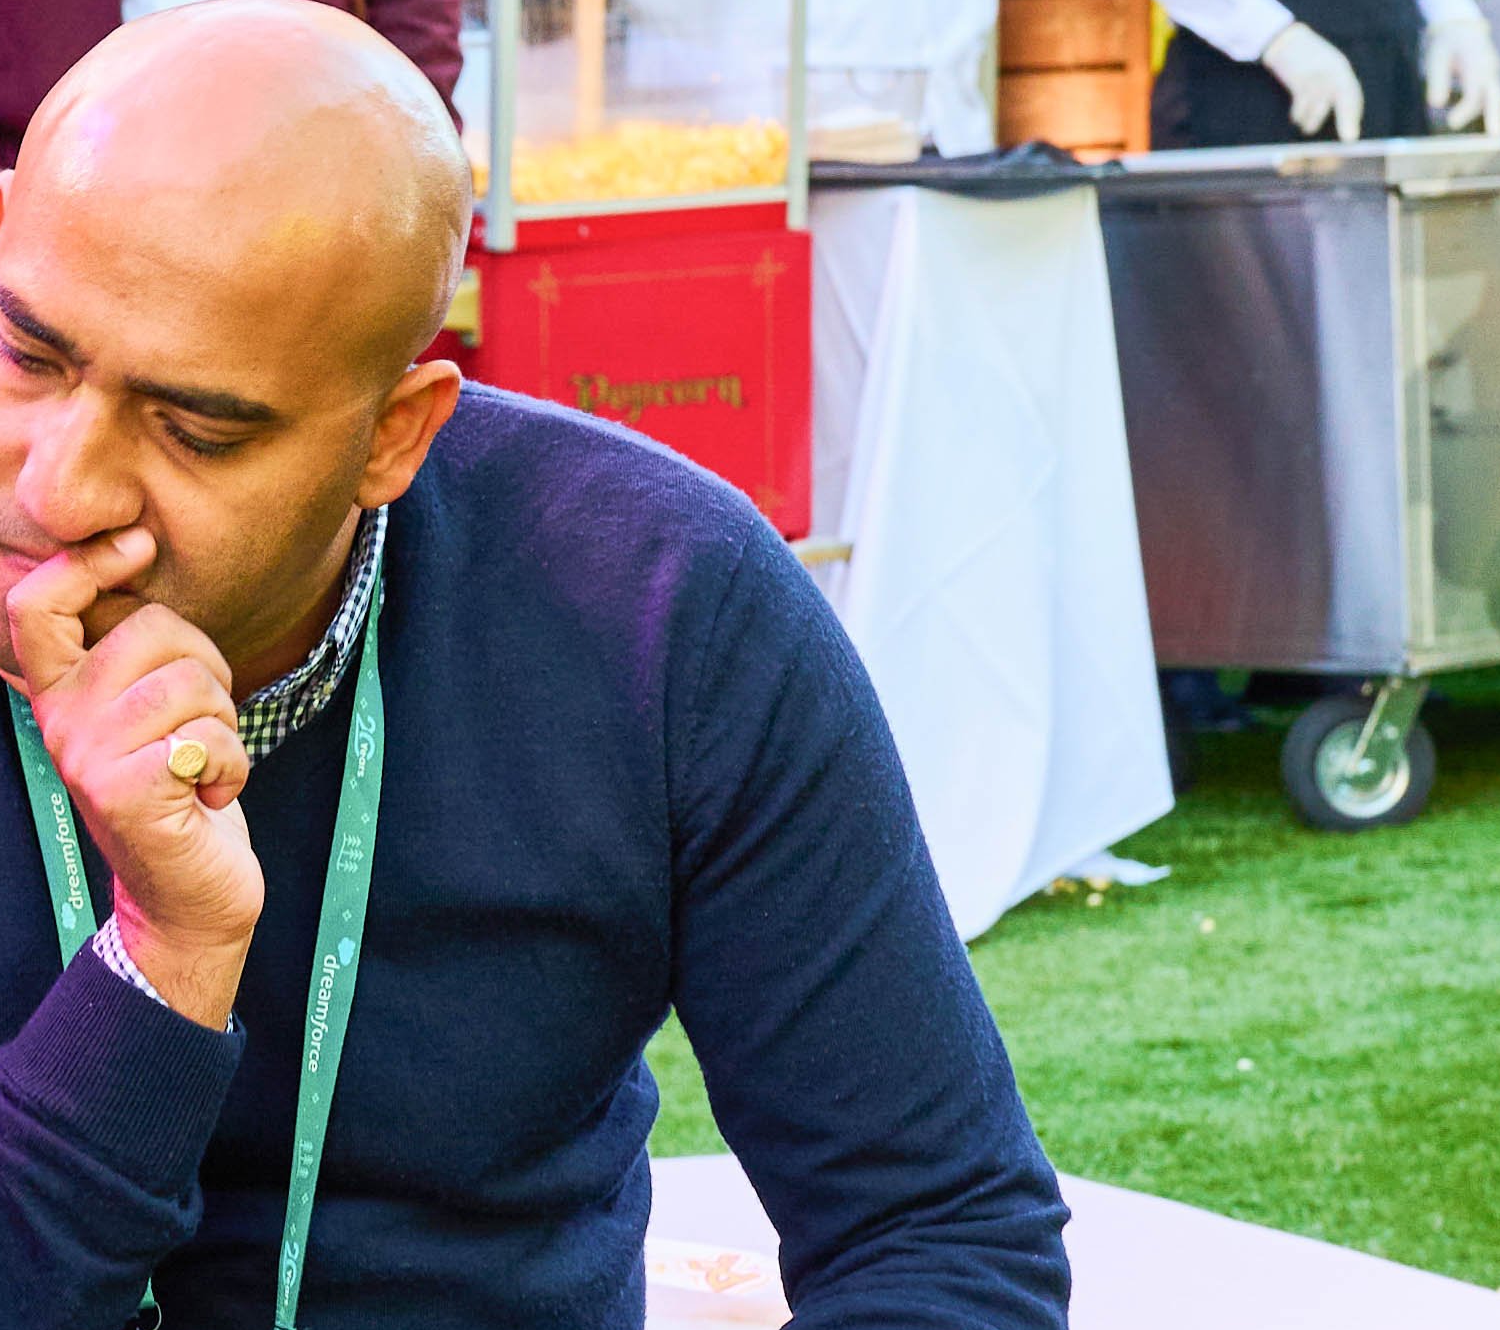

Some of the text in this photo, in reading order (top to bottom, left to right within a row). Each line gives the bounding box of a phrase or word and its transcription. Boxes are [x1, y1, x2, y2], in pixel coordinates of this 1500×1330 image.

[568, 372, 747, 424] Popcorn
[49, 792, 85, 910] dreamforce
[307, 952, 340, 1074] dreamforce
